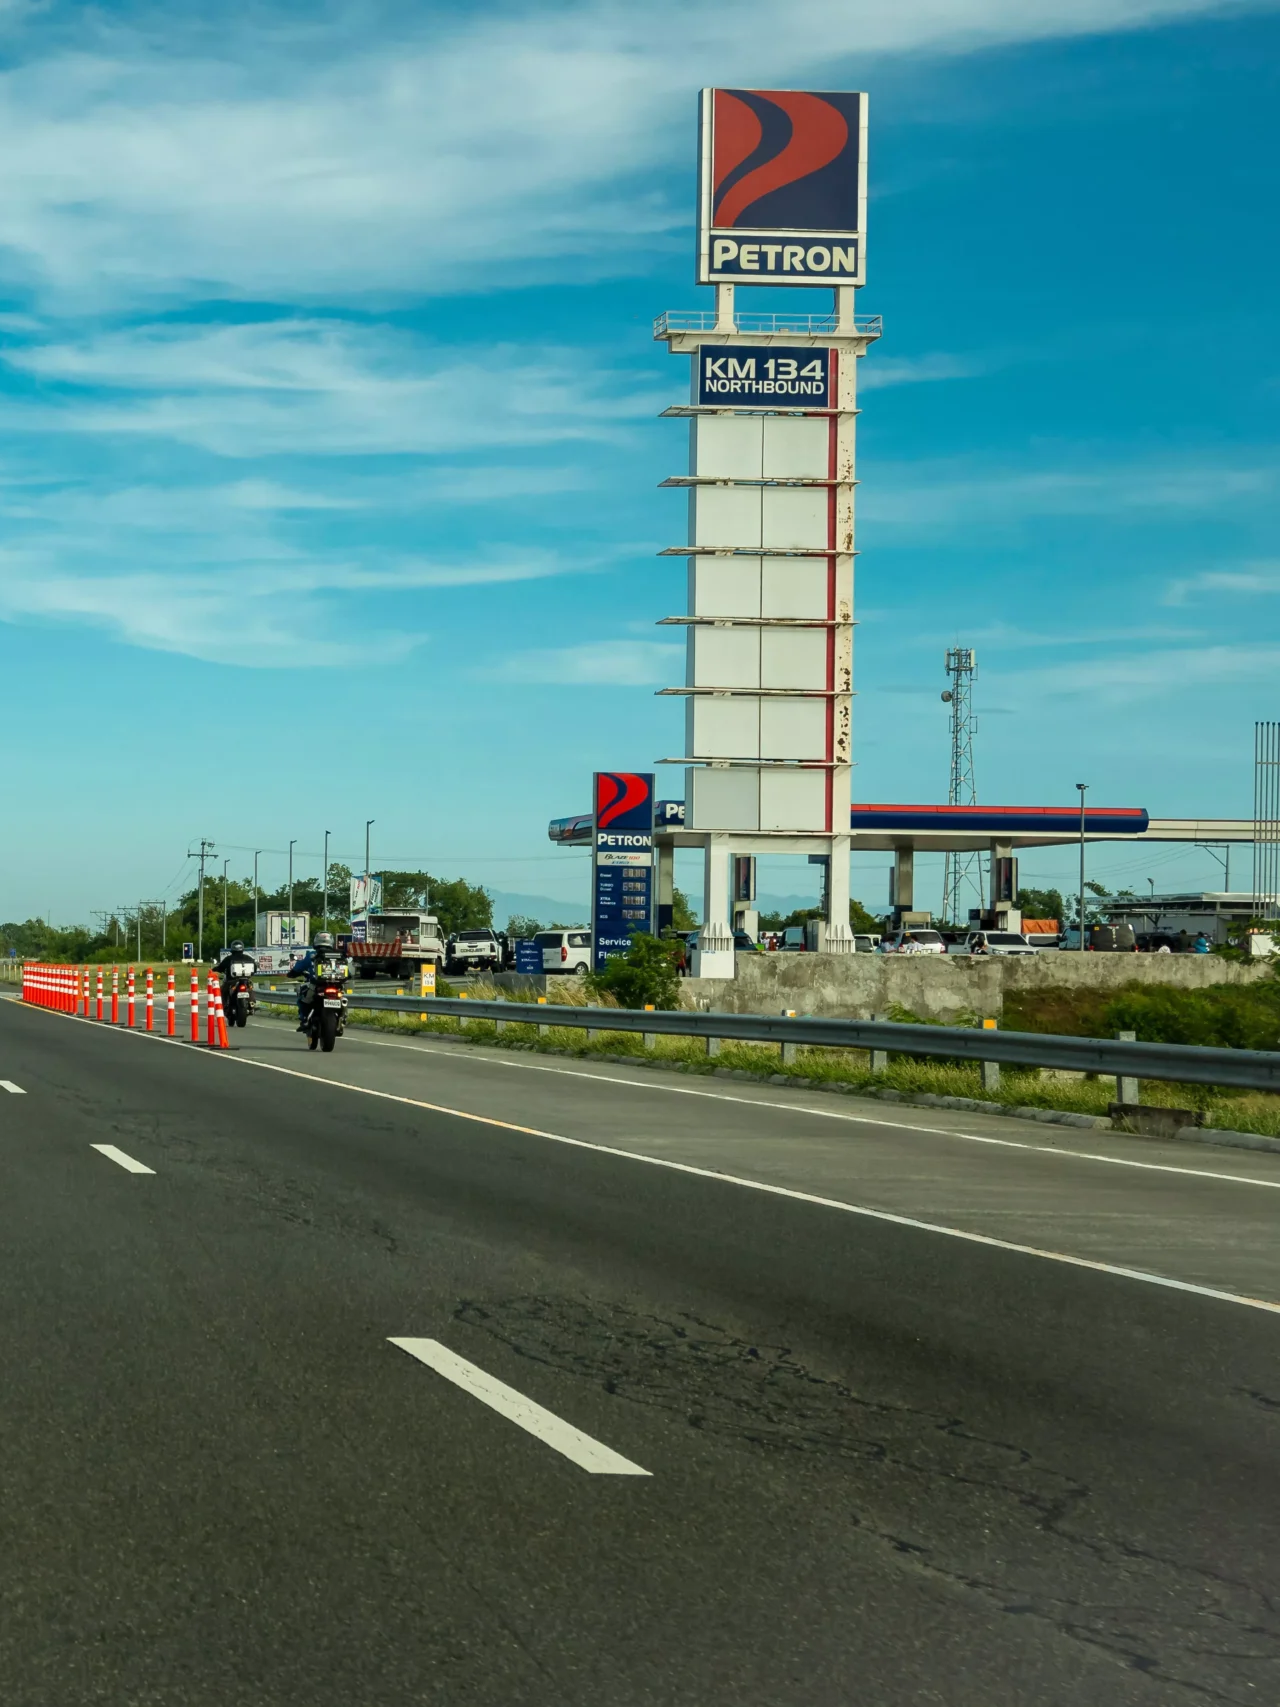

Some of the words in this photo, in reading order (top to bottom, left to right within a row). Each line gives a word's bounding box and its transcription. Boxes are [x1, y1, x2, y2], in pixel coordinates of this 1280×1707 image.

[713, 239, 855, 272] PETRON
[705, 358, 756, 379] KM
[763, 358, 825, 380] 134
[705, 379, 825, 395] NORTHBOUND
[597, 833, 651, 847] PETRON
[599, 937, 632, 946] Service
